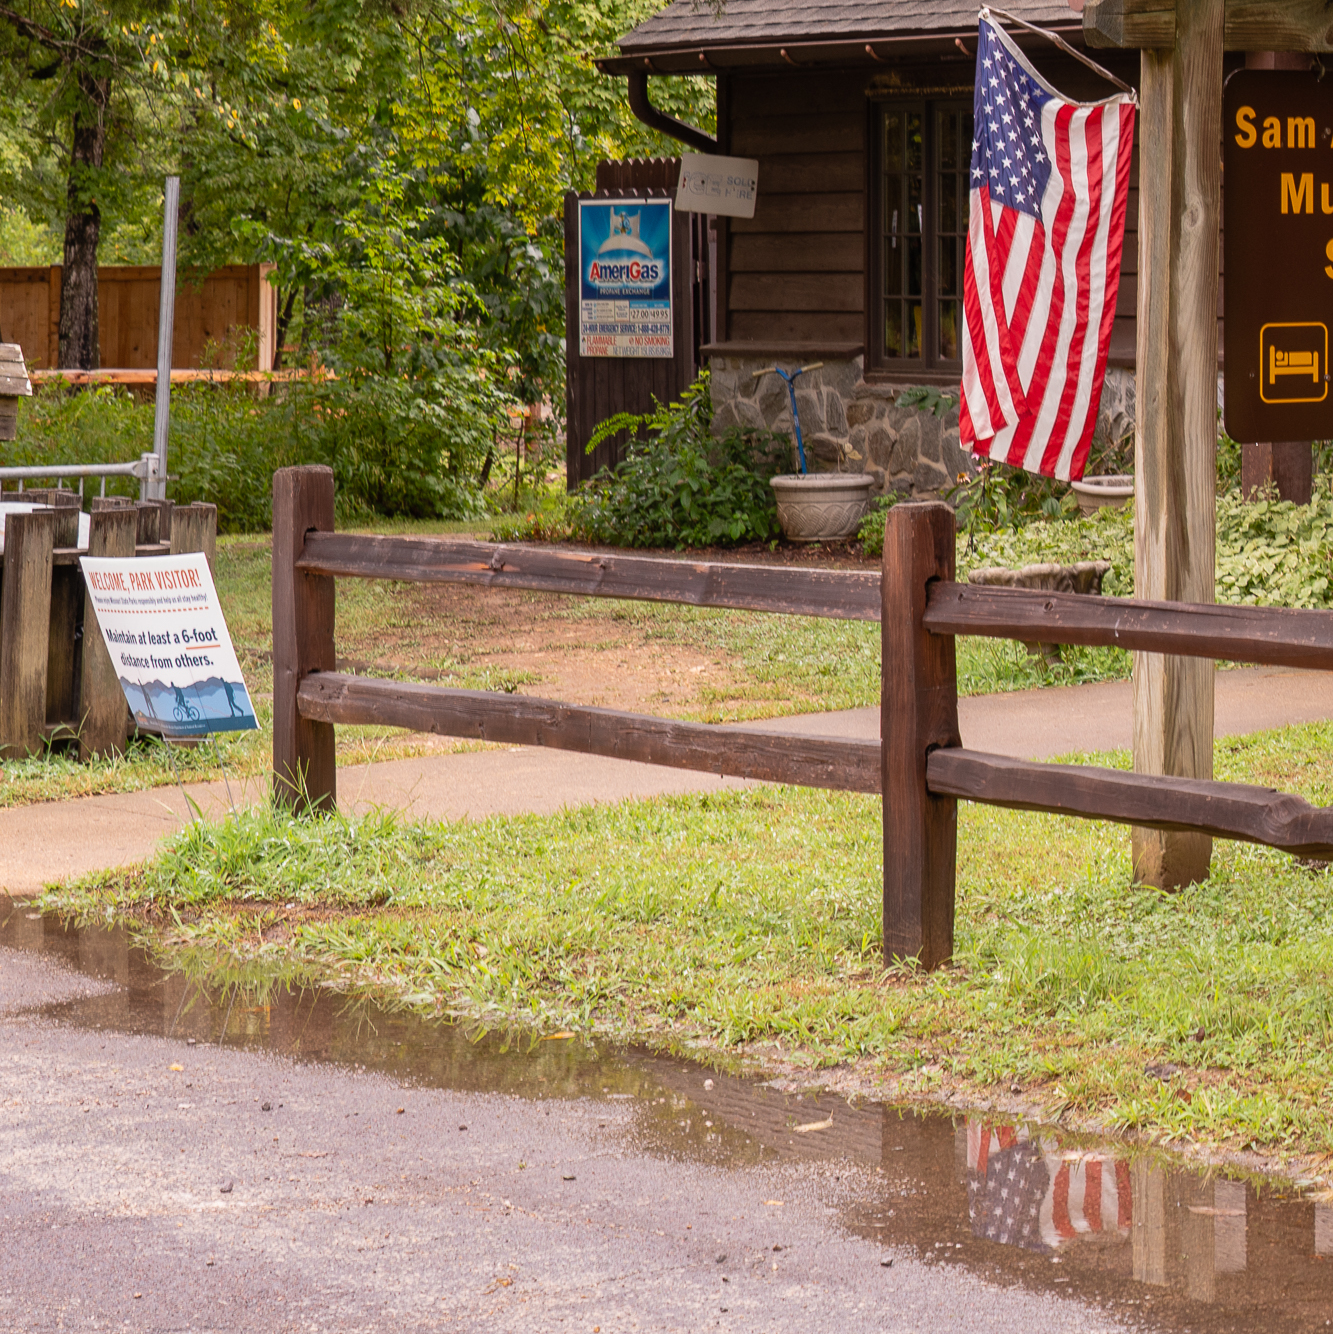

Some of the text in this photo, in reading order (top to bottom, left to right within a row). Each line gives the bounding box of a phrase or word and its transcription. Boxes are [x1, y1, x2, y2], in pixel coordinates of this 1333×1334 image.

[1235, 106, 1315, 149] Sam
[589, 261, 659, 280] AmeriGas
[586, 335, 617, 346] FLAMMABLE
[635, 335, 670, 346] NO SMOKING
[586, 346, 609, 356] PROPANE
[89, 568, 202, 594] WELCOME, PARK VISITOR!
[105, 627, 218, 645] Maintain at least a 6-foot
[120, 652, 214, 669] distance from others.
